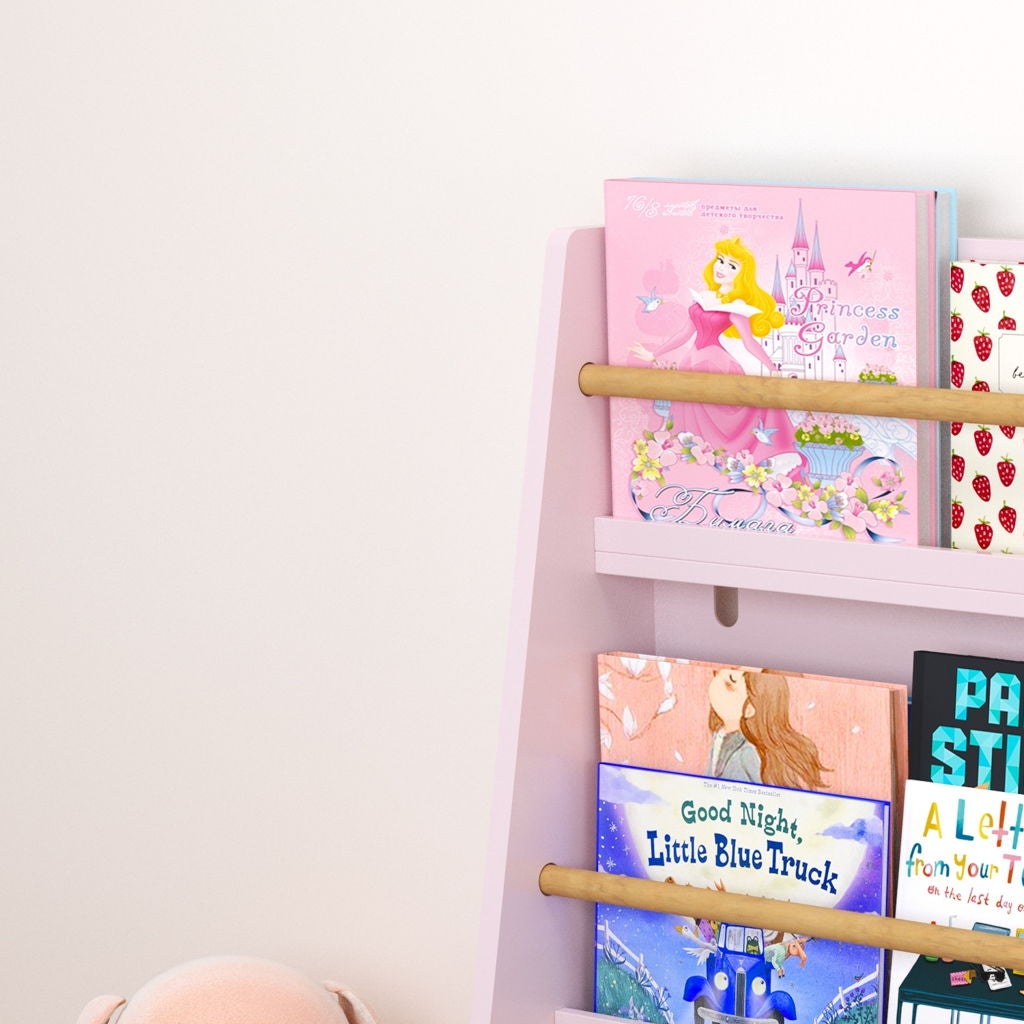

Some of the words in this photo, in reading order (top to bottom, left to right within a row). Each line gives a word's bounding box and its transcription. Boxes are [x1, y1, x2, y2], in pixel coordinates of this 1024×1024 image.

[790, 286, 900, 320] Princess
[794, 322, 898, 356] Garden
[681, 799, 732, 824] Good
[740, 801, 803, 845] Night,
[923, 801, 943, 839] A
[646, 830, 708, 867] Little
[714, 832, 763, 870] Blue
[767, 839, 839, 895] Truck
[905, 842, 950, 878] from
[944, 885, 962, 901] the
[967, 887, 990, 906] last
[995, 895, 1013, 915] day
